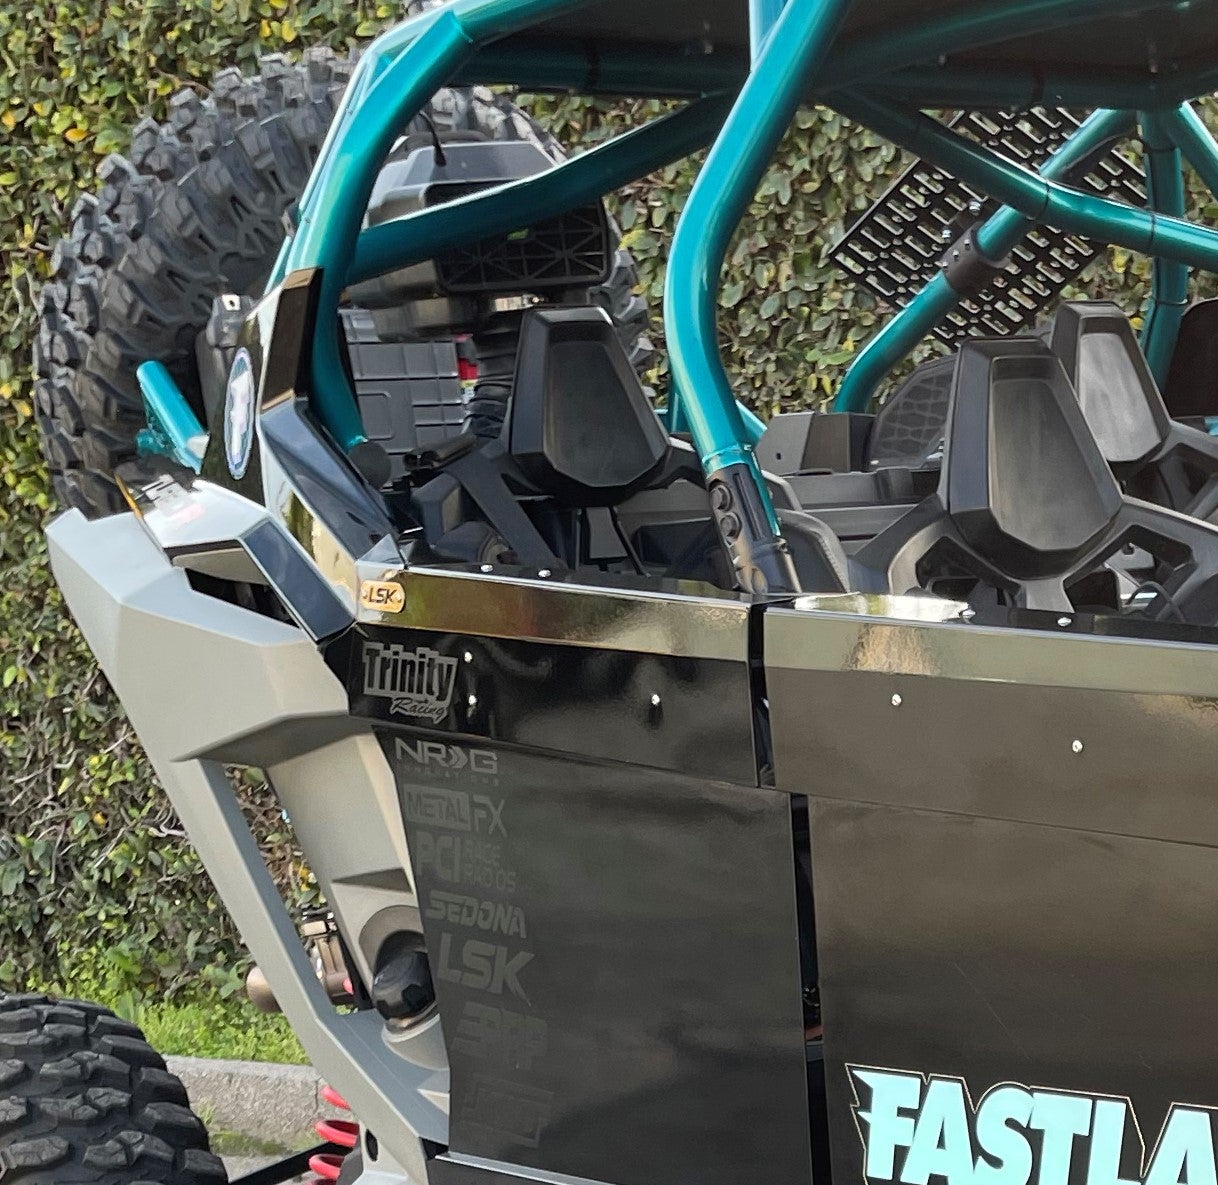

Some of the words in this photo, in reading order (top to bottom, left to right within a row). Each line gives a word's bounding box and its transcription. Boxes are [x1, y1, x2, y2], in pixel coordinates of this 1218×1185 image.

[368, 587, 398, 605] LSK
[363, 644, 457, 703] Trinity
[390, 696, 450, 723] Racing
[425, 888, 527, 940] SEDONA
[437, 931, 535, 1008] LSK
